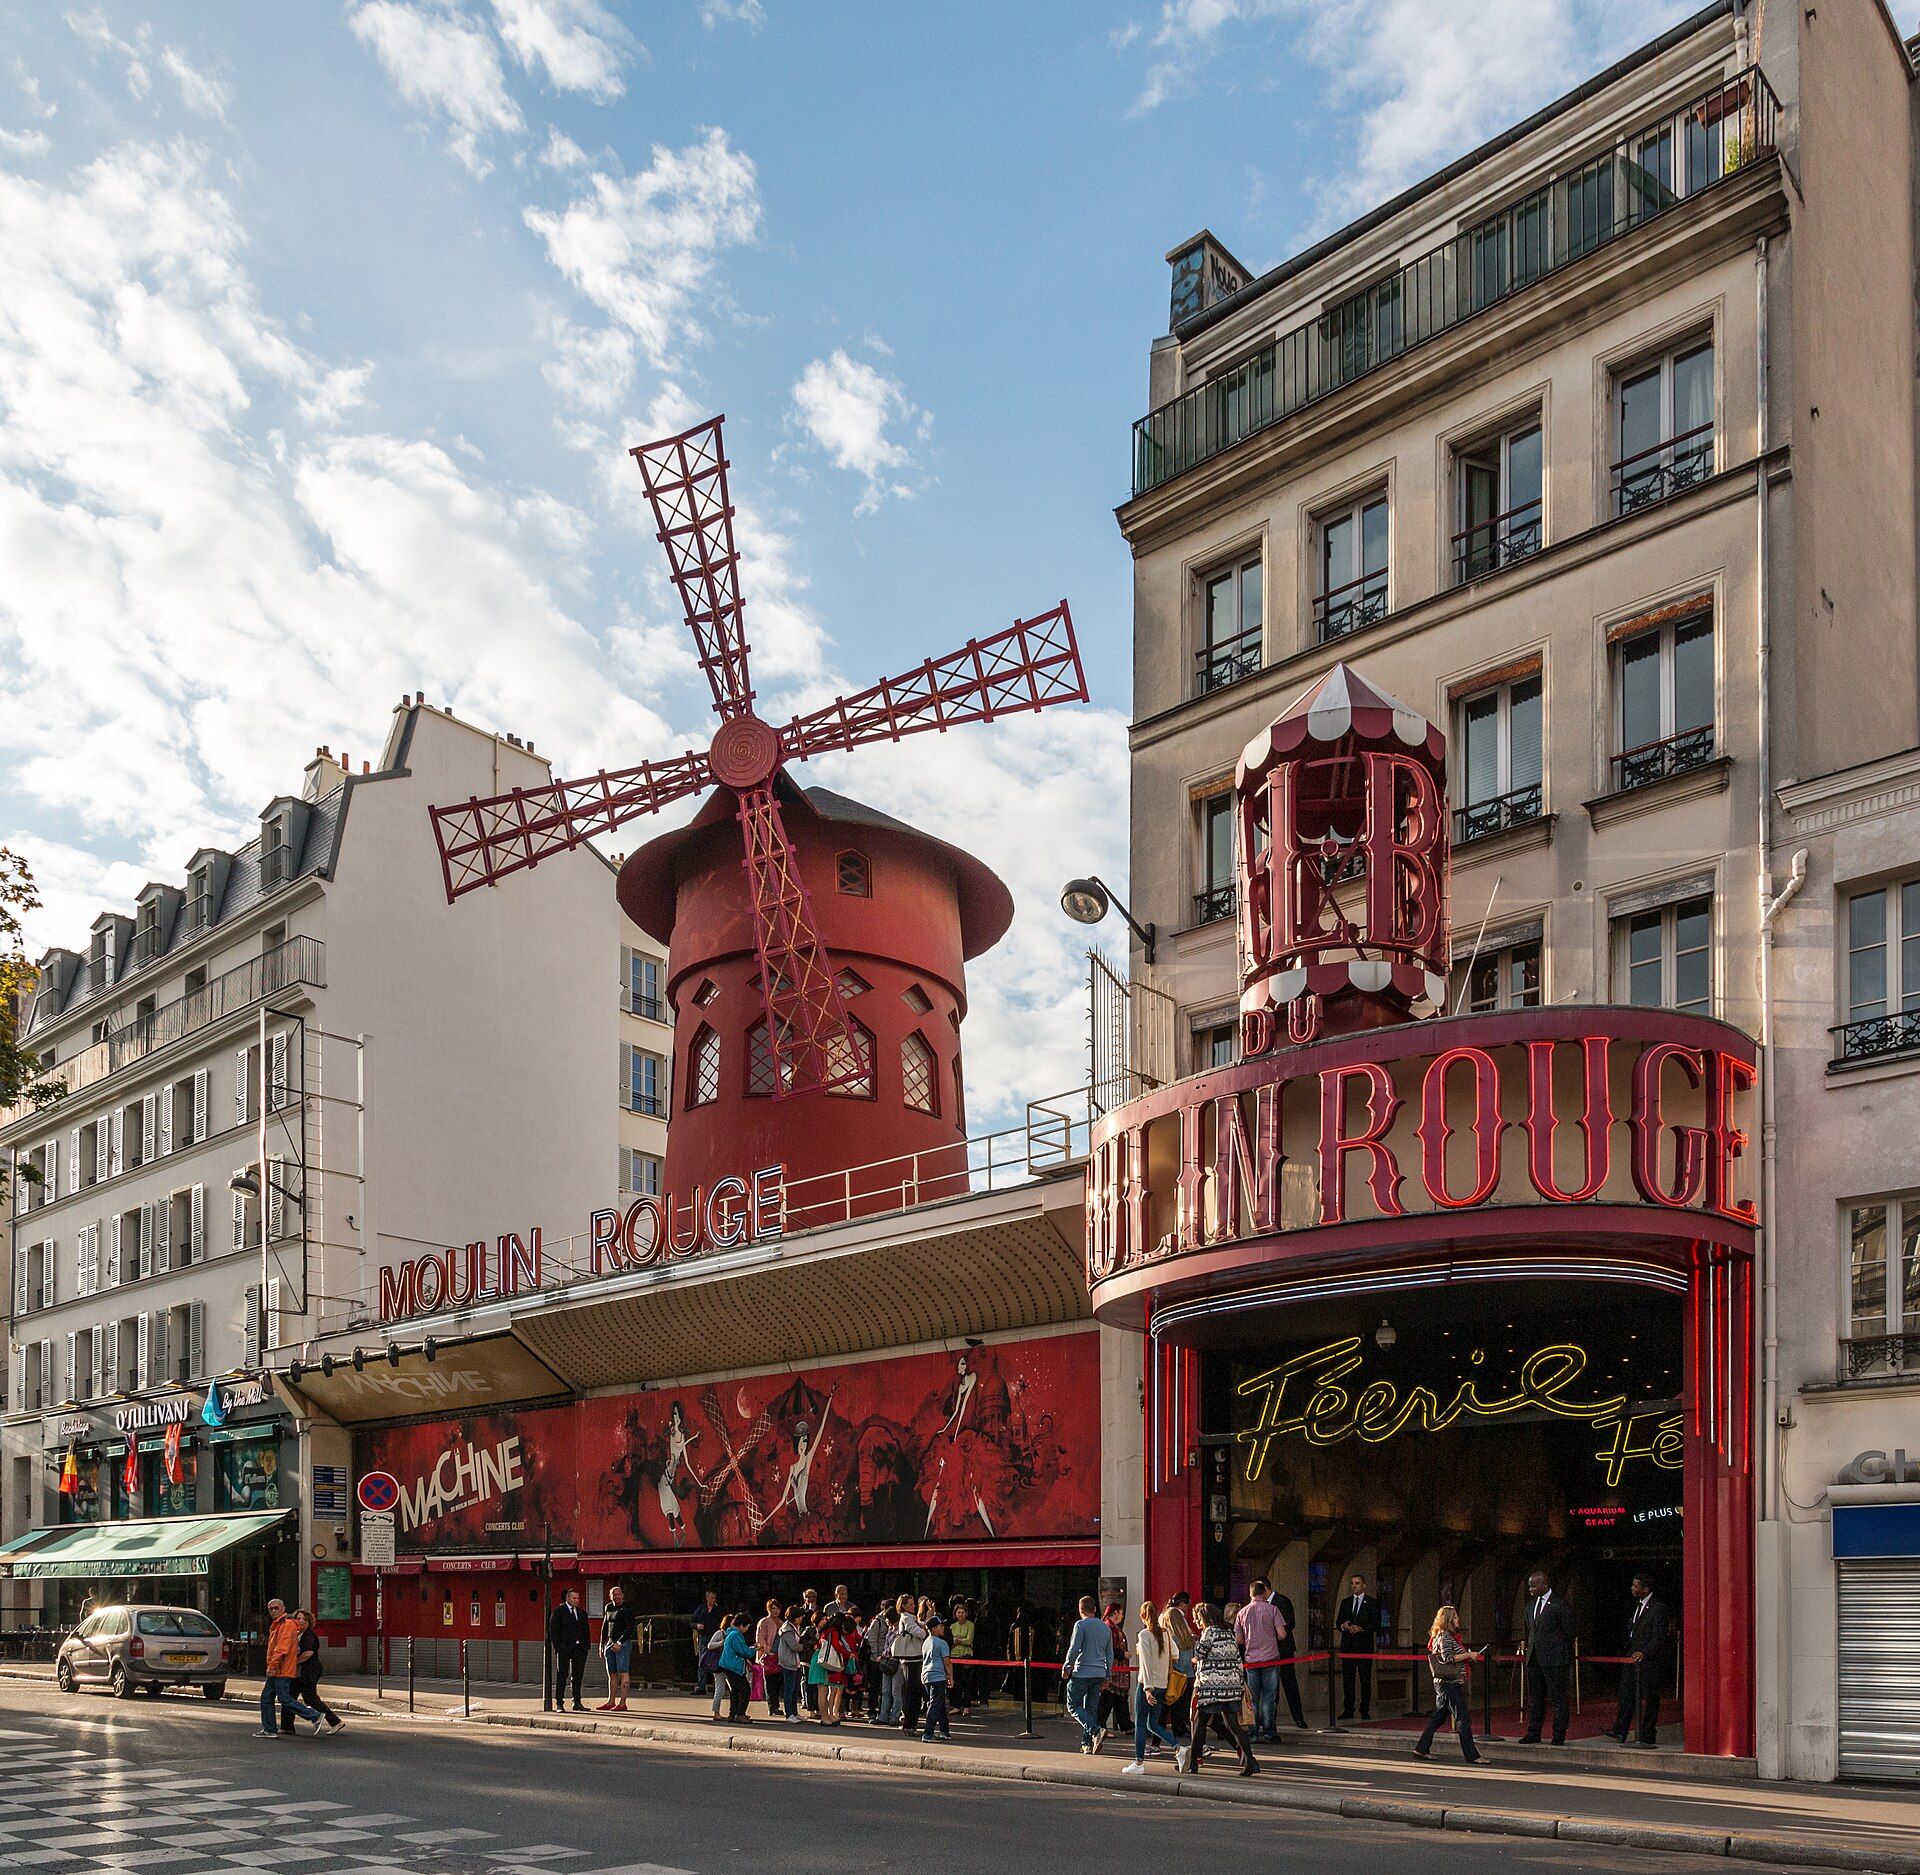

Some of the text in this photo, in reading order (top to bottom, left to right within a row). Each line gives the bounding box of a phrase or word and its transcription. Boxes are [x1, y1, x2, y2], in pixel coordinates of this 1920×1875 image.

[1316, 1036, 1761, 1226] ROUGE
[379, 1163, 786, 1321] MOULIN ROUGE
[222, 1385, 262, 1413] By the Mill
[116, 1400, 190, 1430] O'SULLIVANS
[399, 1436, 524, 1533] MACHINE
[485, 1521, 525, 1531] CONCERTS CLUB
[1634, 1513, 1646, 1523] LE
[1648, 1507, 1673, 1520] PLUS
[442, 1560, 496, 1570] CONCERTS CLUB
